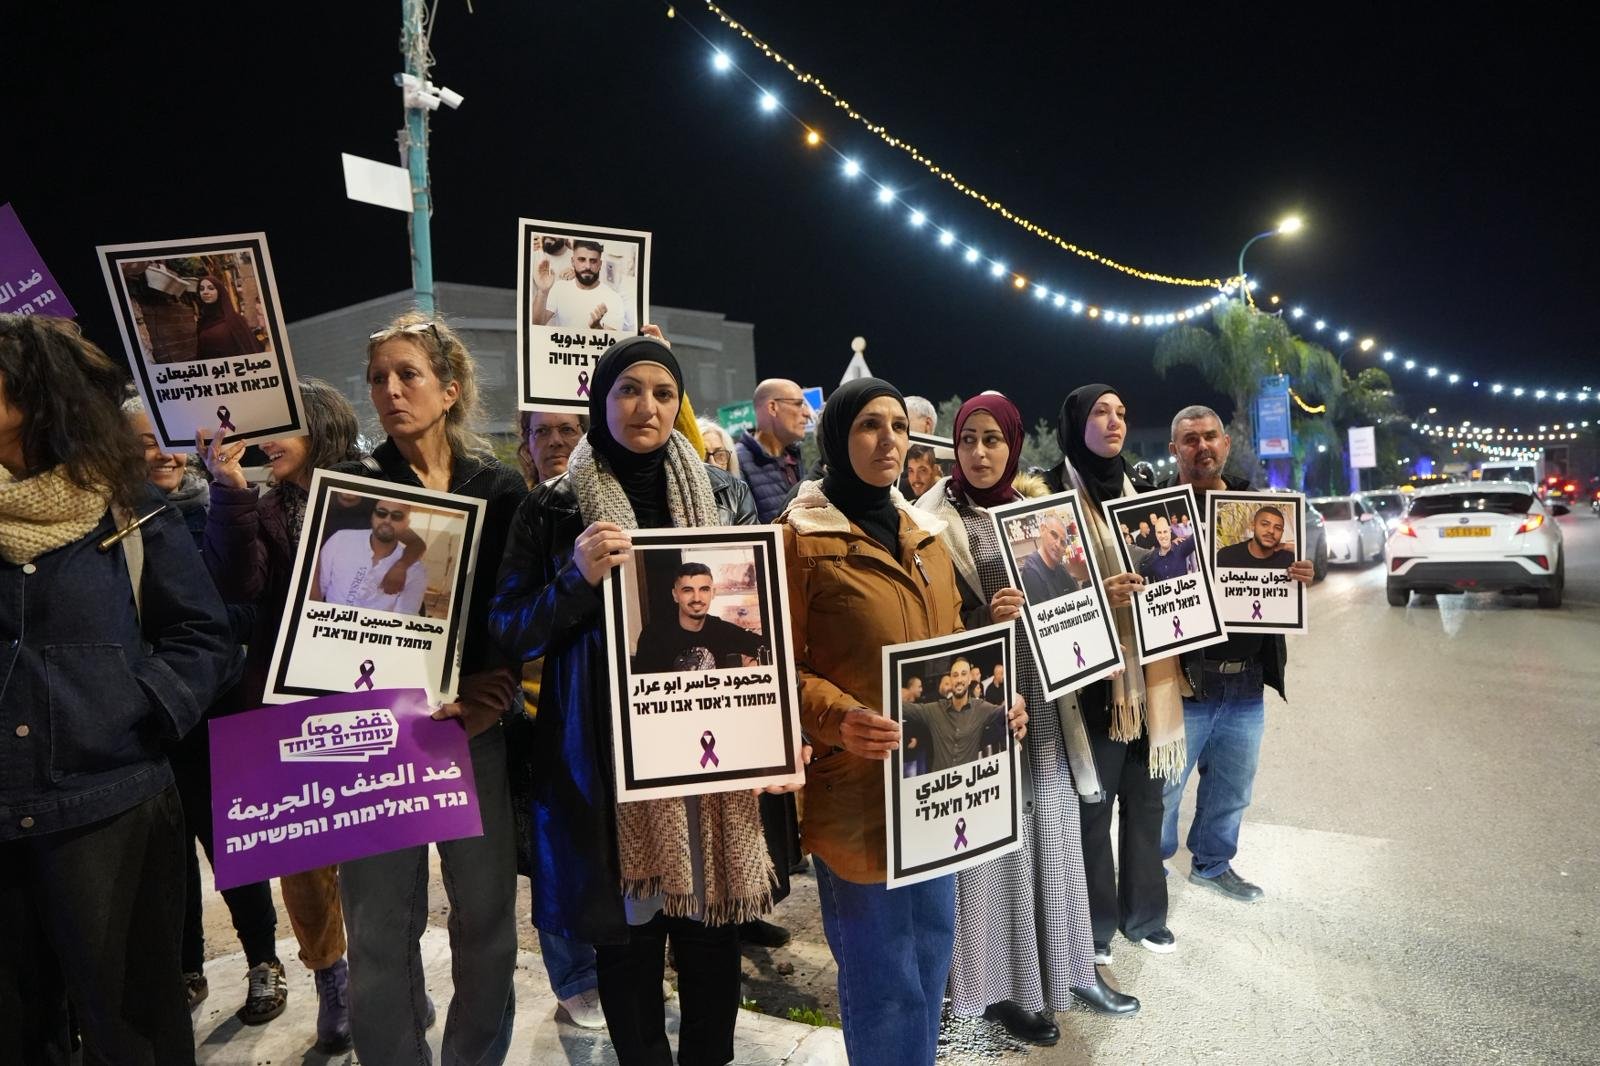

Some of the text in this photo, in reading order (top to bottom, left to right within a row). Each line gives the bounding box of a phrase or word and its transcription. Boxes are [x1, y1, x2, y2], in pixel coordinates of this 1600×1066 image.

[18, 269, 42, 293] ضد
[32, 289, 57, 308] נגד
[550, 332, 586, 348] بدويه
[156, 358, 272, 385] صباح ابو القيعان
[549, 352, 588, 367] בדוויה
[155, 375, 280, 403] סבאח אבו אלקיעאן
[1220, 570, 1258, 584] سليمان
[1076, 594, 1093, 611] راسم
[1145, 579, 1197, 605] جمال خالدي
[1225, 585, 1260, 598] סלימאן
[306, 607, 444, 635] محمد حسين الترابين
[1038, 609, 1100, 638] ראסם נעאמנה עראבה
[312, 624, 433, 650] מחמד חוסין טראבין
[633, 673, 773, 696] محمود جاسر ابو عرار
[633, 692, 777, 716] מחמוד ג'אסר אבו עראר
[349, 712, 392, 730] نقف
[284, 727, 393, 753] עומדים ביחד
[227, 760, 462, 822] ضد العنف والجريمة
[915, 758, 1000, 805] نضال خالدي
[915, 785, 1000, 822] נידאל ח'אלדי
[225, 790, 468, 854] נגד האלימות והפשיעה
